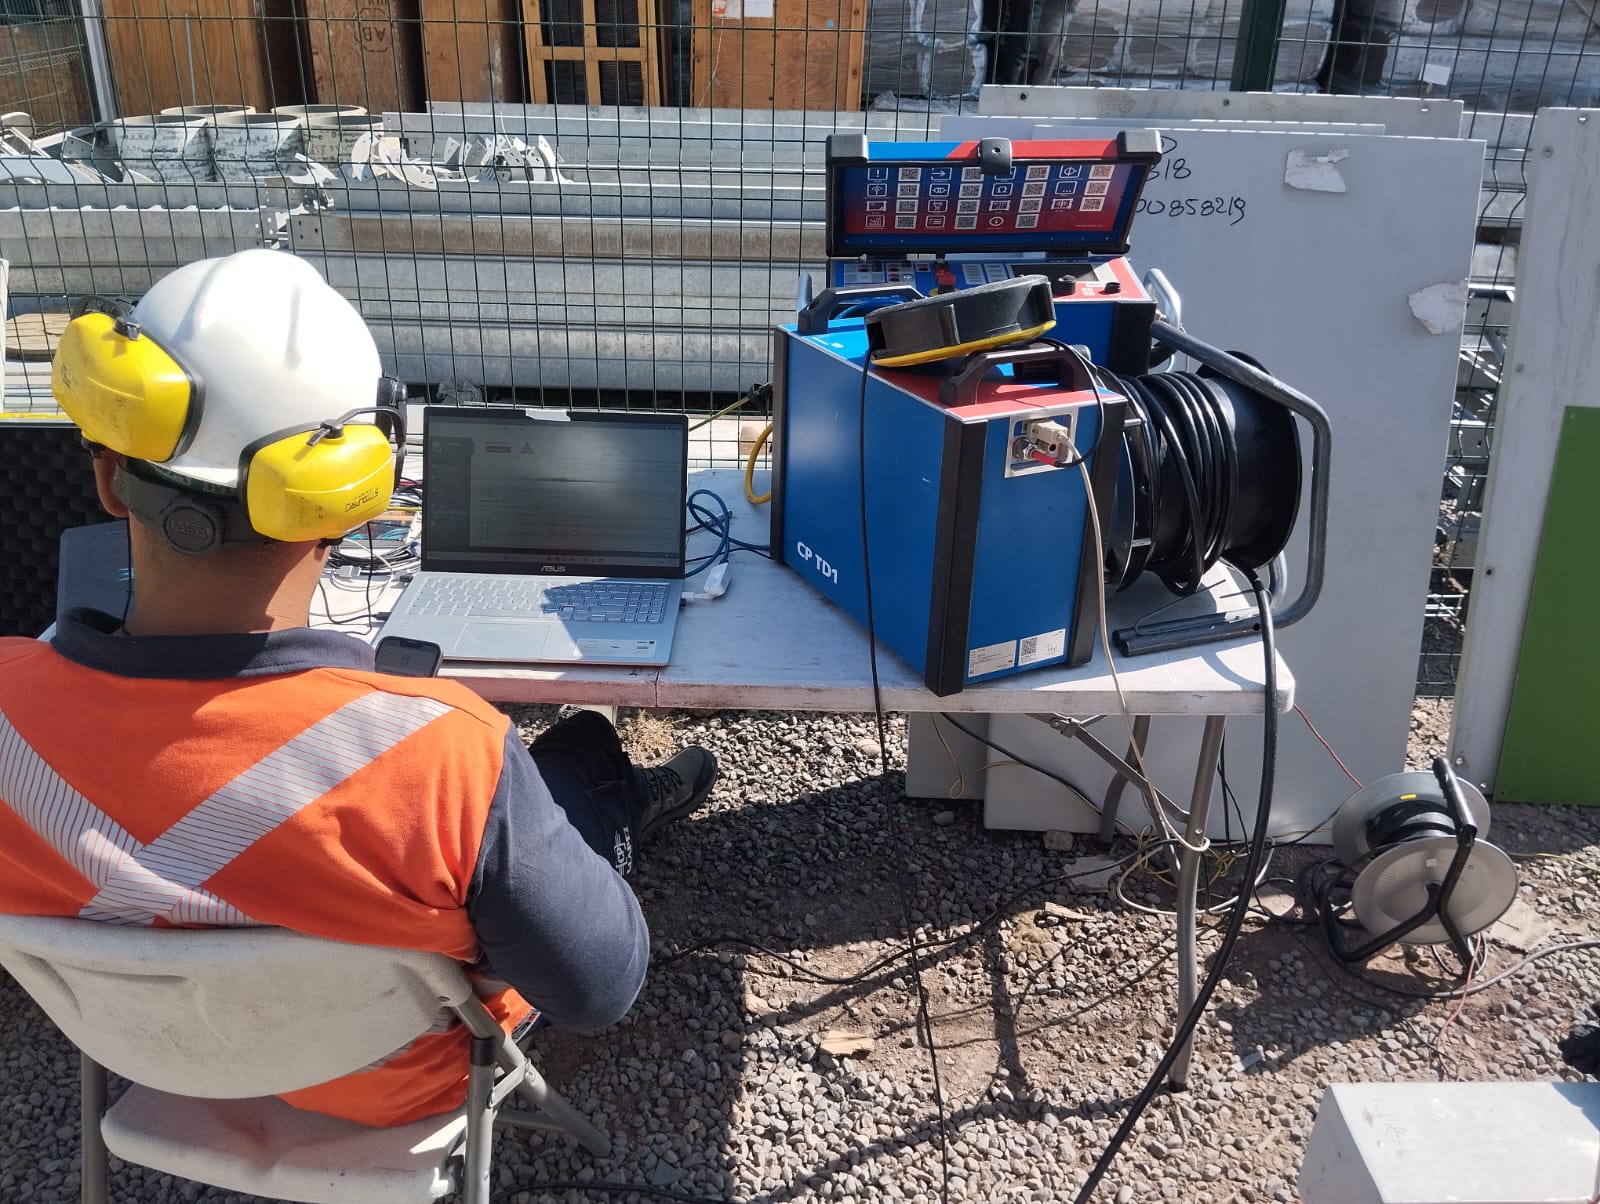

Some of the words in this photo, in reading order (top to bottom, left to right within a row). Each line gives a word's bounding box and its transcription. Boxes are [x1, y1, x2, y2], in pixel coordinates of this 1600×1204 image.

[362, 26, 386, 42] AB
[797, 541, 813, 561] CP
[815, 553, 838, 585] TD1
